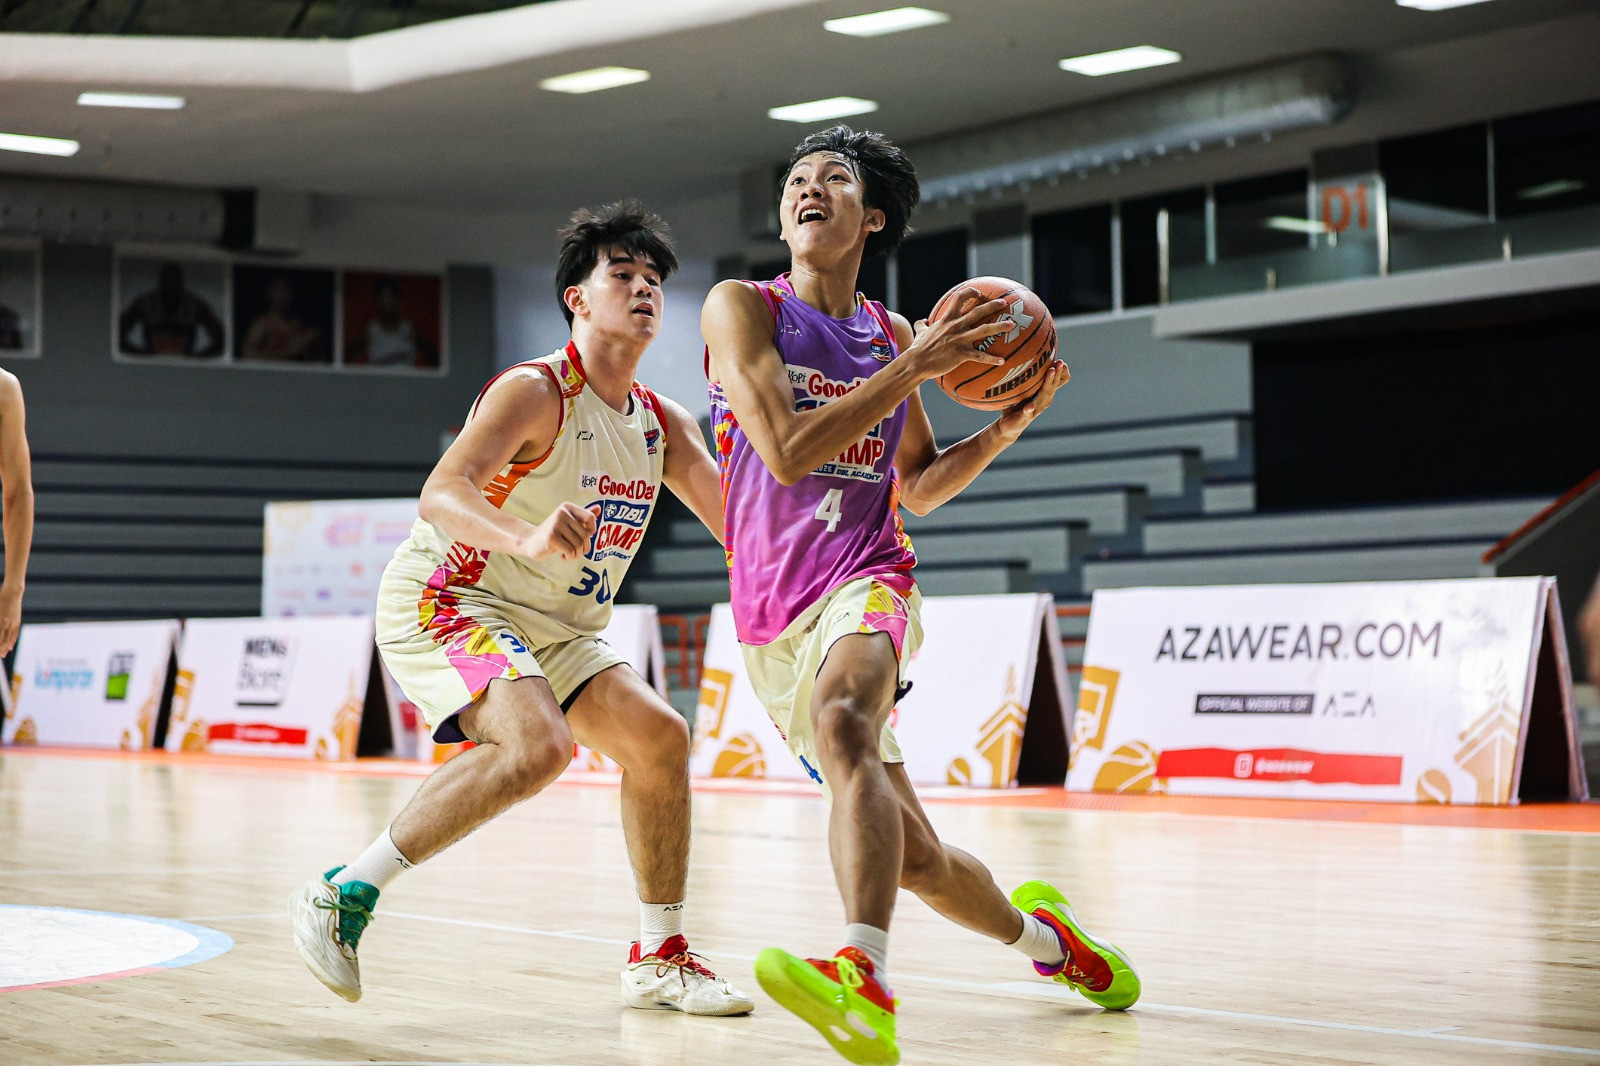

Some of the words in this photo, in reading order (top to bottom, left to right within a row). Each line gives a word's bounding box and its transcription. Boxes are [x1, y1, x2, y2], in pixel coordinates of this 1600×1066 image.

[613, 504, 647, 524] DBL
[814, 488, 843, 533] 4
[596, 523, 644, 551] CAMP
[567, 565, 612, 605] 30
[1155, 621, 1442, 663] AZAWEAR.COM
